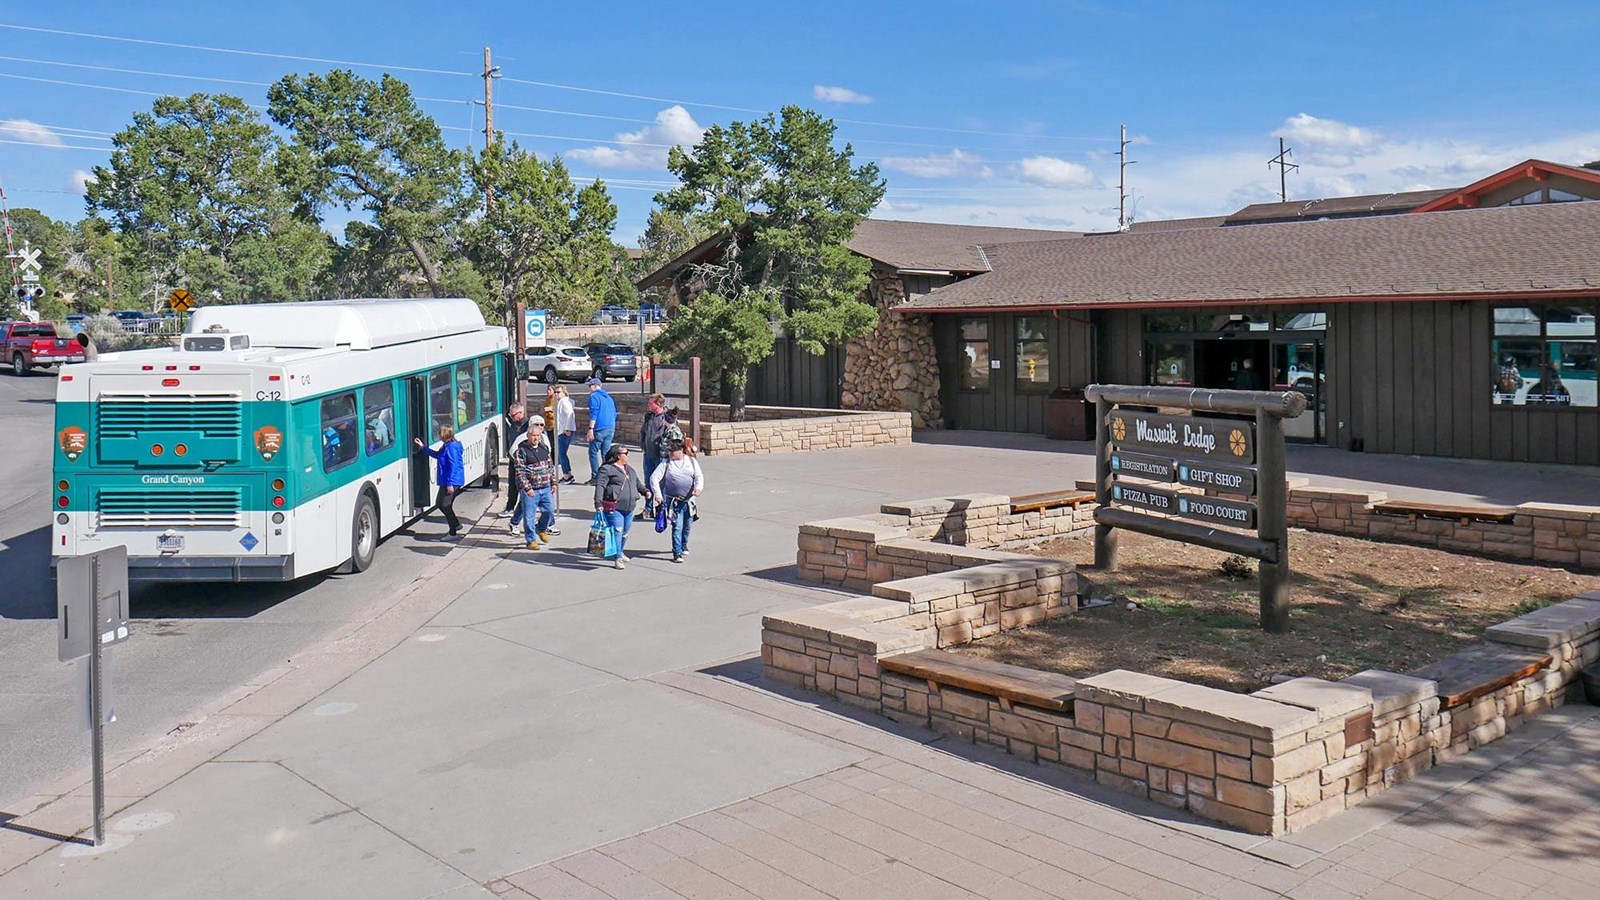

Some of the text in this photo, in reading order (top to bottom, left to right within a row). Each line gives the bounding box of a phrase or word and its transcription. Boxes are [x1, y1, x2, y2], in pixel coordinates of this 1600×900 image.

[301, 375, 310, 385] C-12
[256, 391, 281, 401] C-12
[1136, 418, 1216, 454] Maswik Lodge
[1121, 459, 1168, 475] REGISTRATION
[142, 475, 204, 485] Grand Canyon
[1190, 469, 1242, 488] GIFT SHOP
[1123, 489, 1169, 508] PIZZA PUB
[1190, 502, 1247, 522] FOOD COURT
